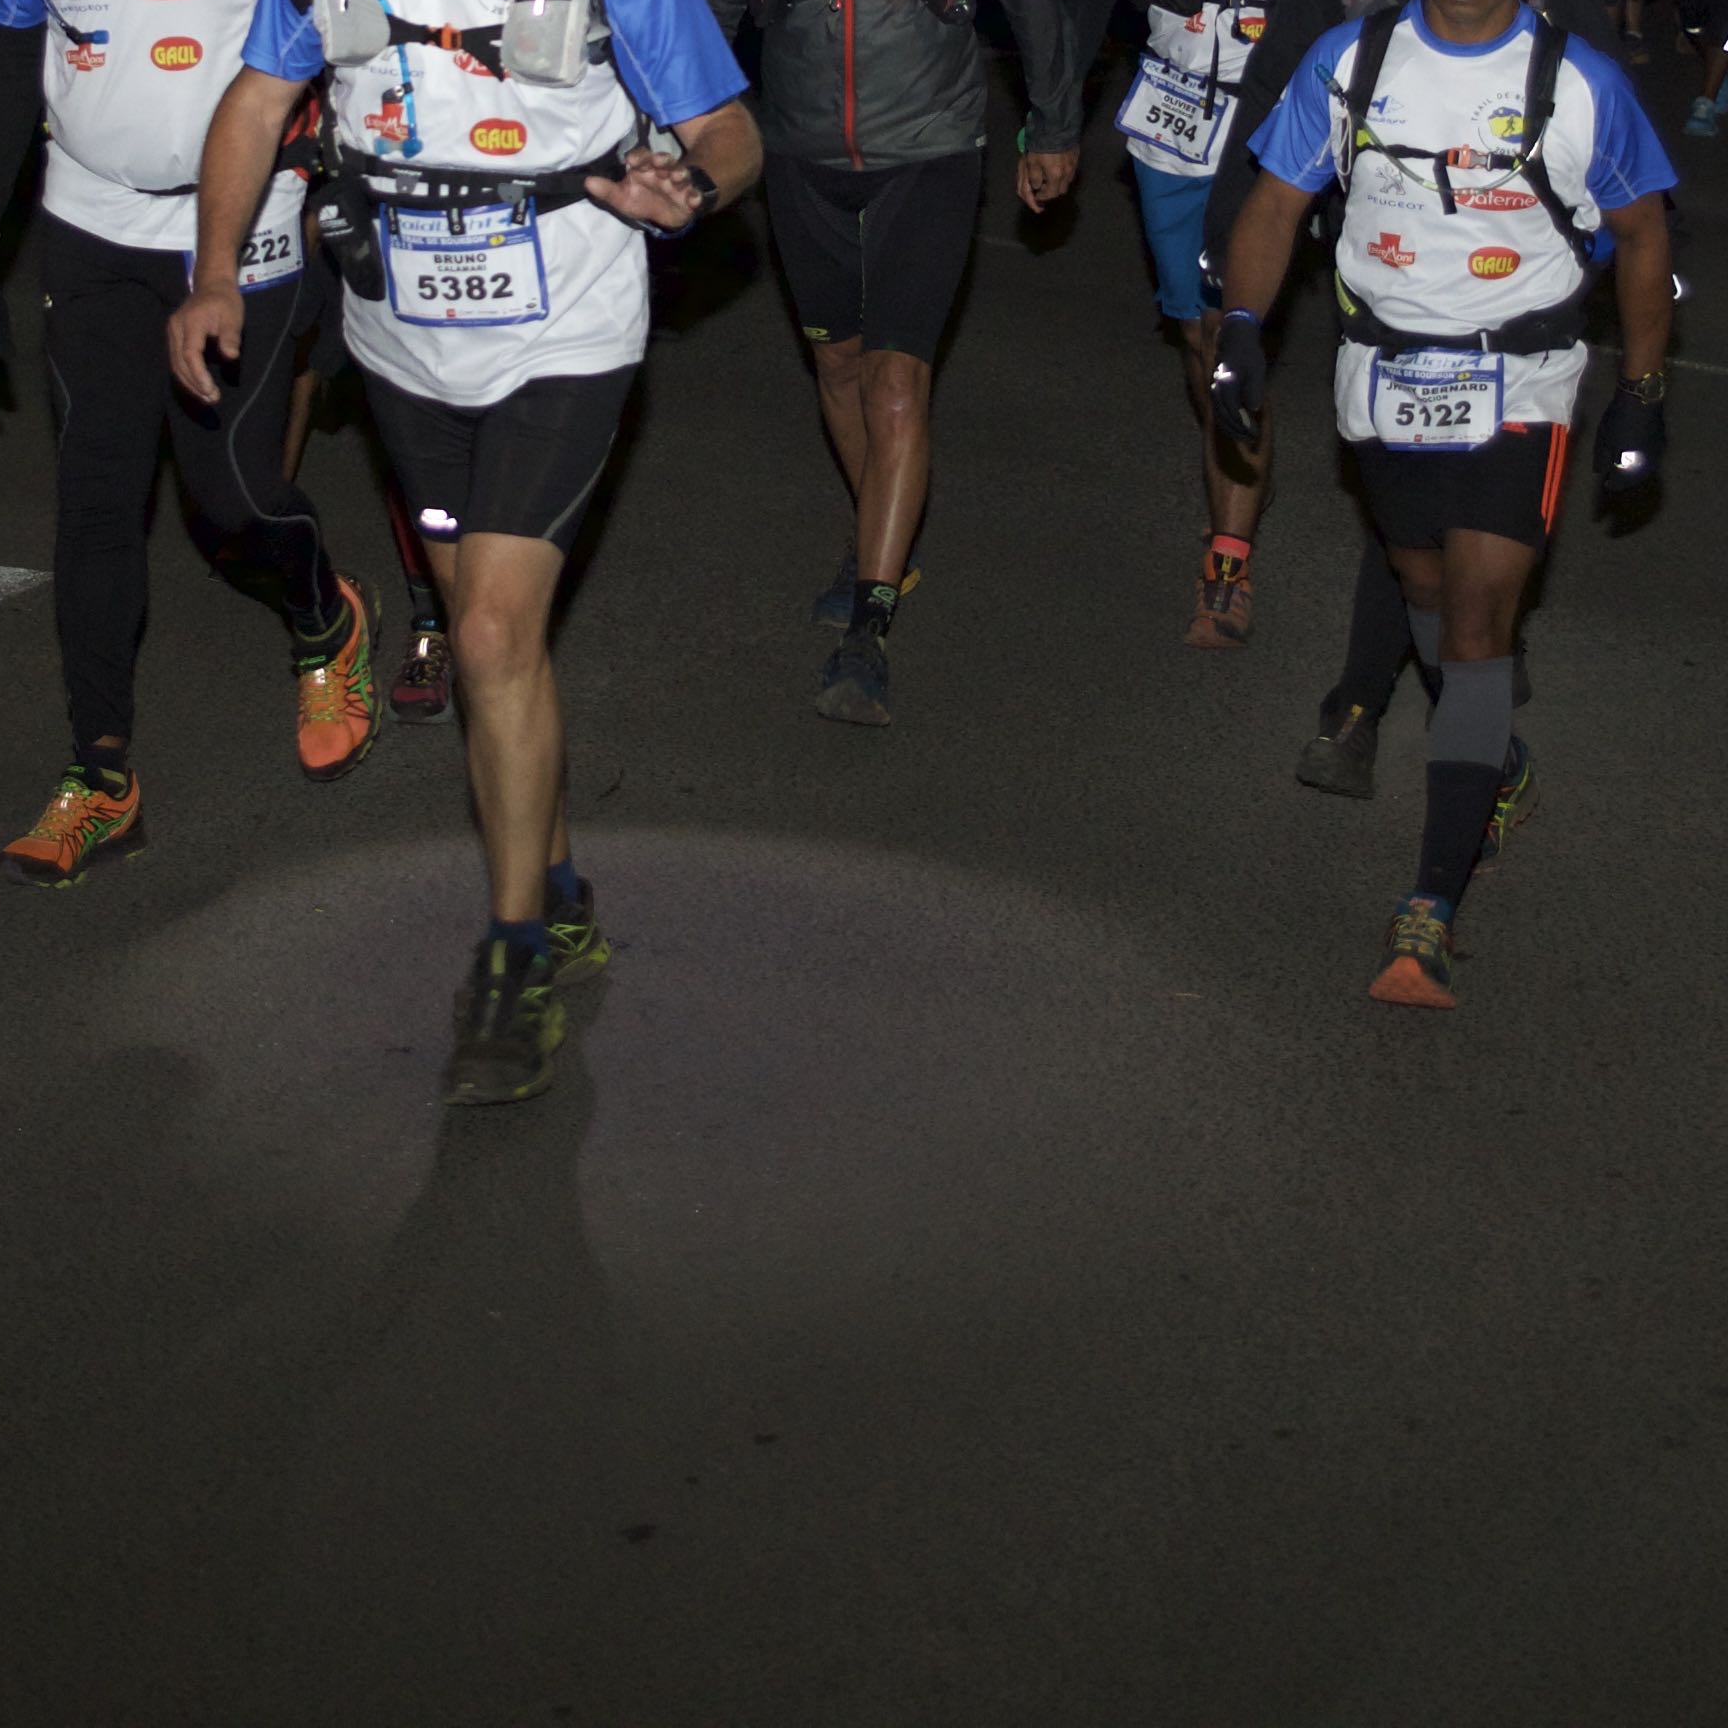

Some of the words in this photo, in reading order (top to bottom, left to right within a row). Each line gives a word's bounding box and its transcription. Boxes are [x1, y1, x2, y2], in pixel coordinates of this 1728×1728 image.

[153, 45, 198, 67] GAUL
[1145, 104, 1198, 143] 5794
[473, 127, 524, 149] GAUL
[1367, 195, 1425, 211] PEUGEOT
[241, 233, 291, 267] 222
[433, 252, 487, 264] BRUNO
[1472, 255, 1515, 275] GAUL
[417, 271, 514, 301] 5382
[1395, 400, 1471, 427] 5122
